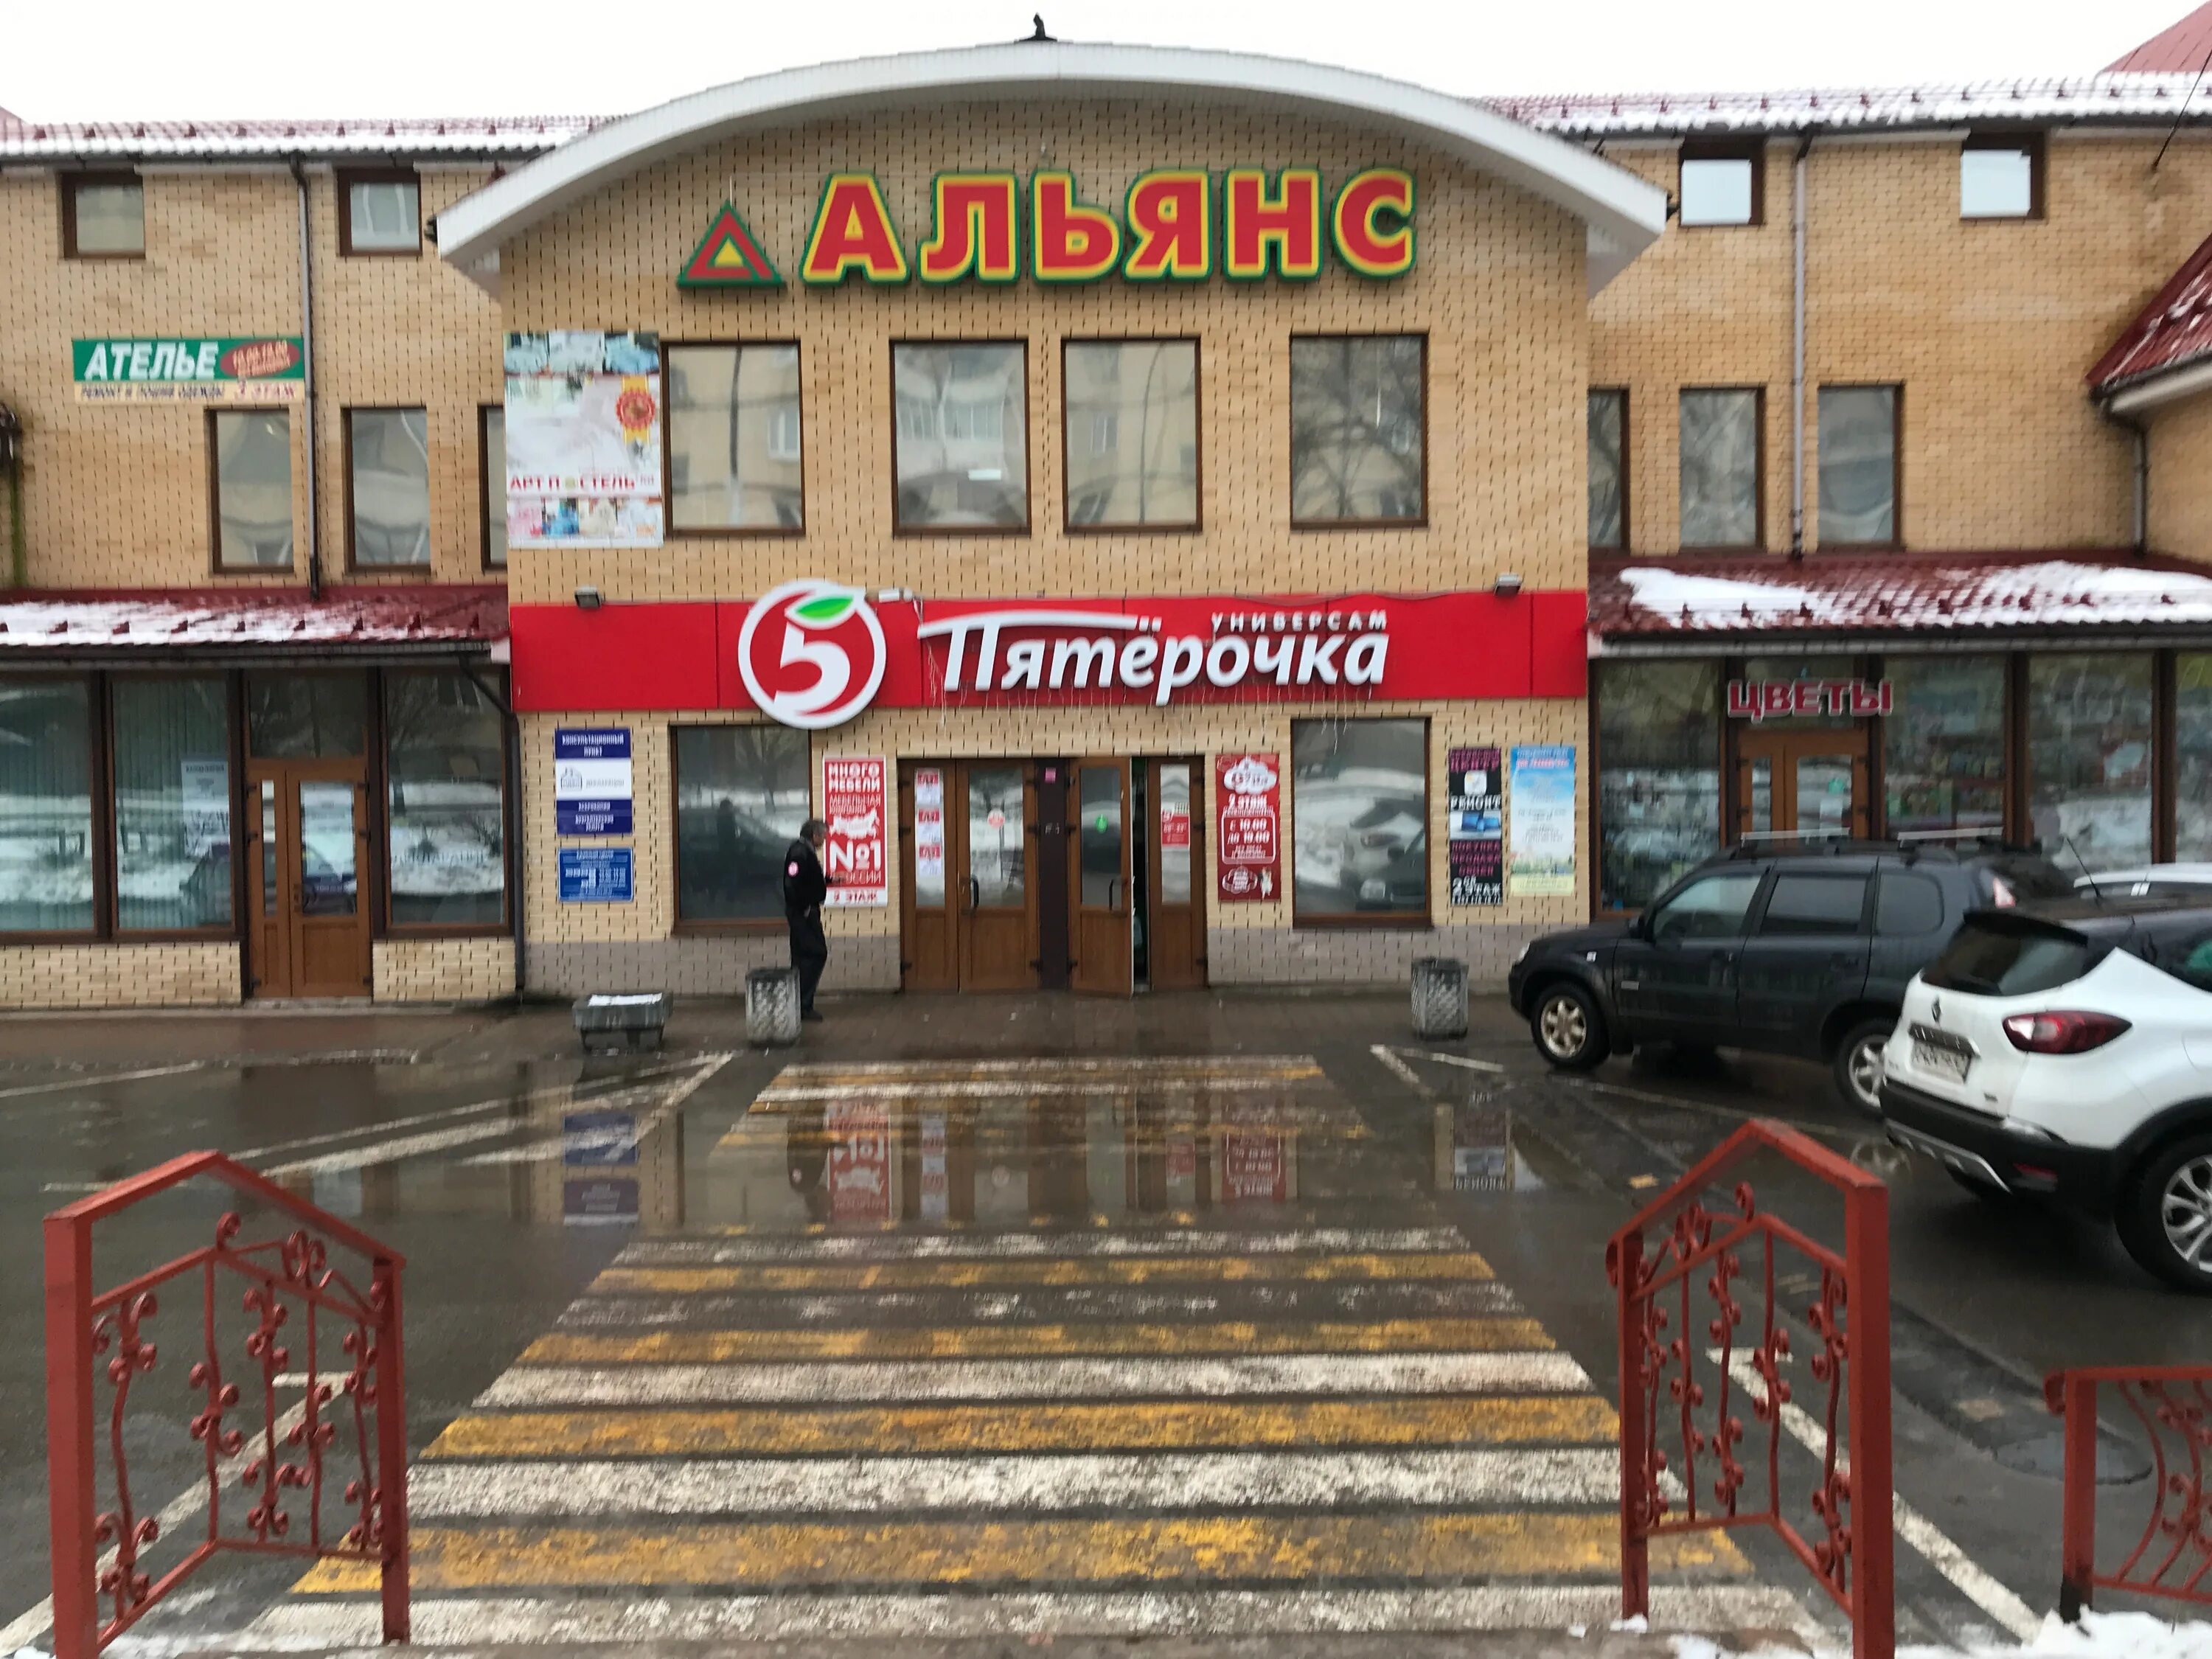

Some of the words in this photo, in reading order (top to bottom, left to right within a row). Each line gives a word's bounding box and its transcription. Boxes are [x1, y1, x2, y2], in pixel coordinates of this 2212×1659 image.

[801, 168, 1415, 285] АЛЬЯНС
[84, 341, 219, 381] АТЕЛЬЕ
[509, 475, 543, 490] АРТ
[1211, 610, 1388, 633] УНИВЕРСАМ
[773, 608, 852, 714] 5
[917, 610, 1389, 706] Пятёрочка
[1727, 678, 1893, 724] ЦВЕТЫ
[562, 733, 625, 746] КОНСУЛЬТАЦИОННЫЙ
[583, 746, 602, 757] ПУНКТ
[828, 762, 880, 778] МНОГО
[828, 777, 880, 793] МЕБЕЛИ
[829, 793, 881, 806] МЕБЕЛЬНАЯ
[1239, 794, 1267, 808] ЭТАЖ
[1450, 795, 1501, 811] РЕМОНТ
[829, 839, 881, 872] №1
[841, 871, 881, 884] ОССИИ
[845, 889, 878, 902] ЭТАЖ
[1466, 883, 1501, 897] ЭТАЖ
